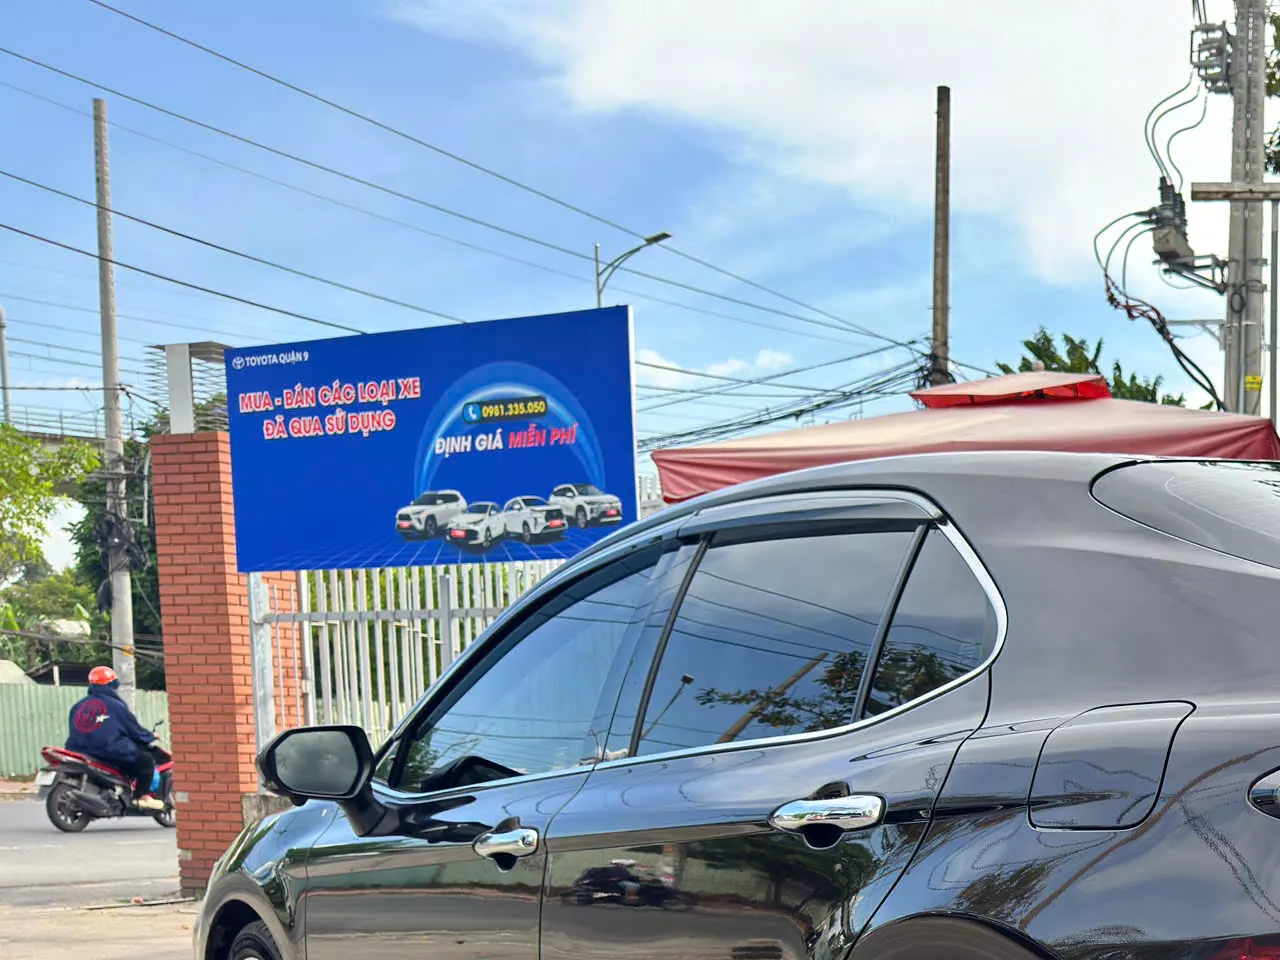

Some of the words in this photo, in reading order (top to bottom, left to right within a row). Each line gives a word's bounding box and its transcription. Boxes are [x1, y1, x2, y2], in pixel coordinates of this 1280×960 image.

[245, 354, 278, 366] TOYOTA
[279, 350, 302, 365] QUẬN
[303, 351, 309, 361] 9
[239, 391, 273, 413] MUA
[283, 383, 316, 409] BÁN
[319, 379, 356, 405] CÁC
[358, 379, 396, 406] LOẠI
[398, 377, 421, 399] XE
[482, 401, 546, 417] 0981.335.050
[263, 414, 288, 439] ĐÃ
[289, 416, 324, 436] QUA
[325, 408, 347, 435] SỬ
[348, 409, 395, 437] DỤNG
[435, 434, 472, 458] ĐỊNH
[475, 428, 503, 451] GIÁ
[508, 423, 546, 448] MIỄN
[550, 422, 579, 445] PHÍ
